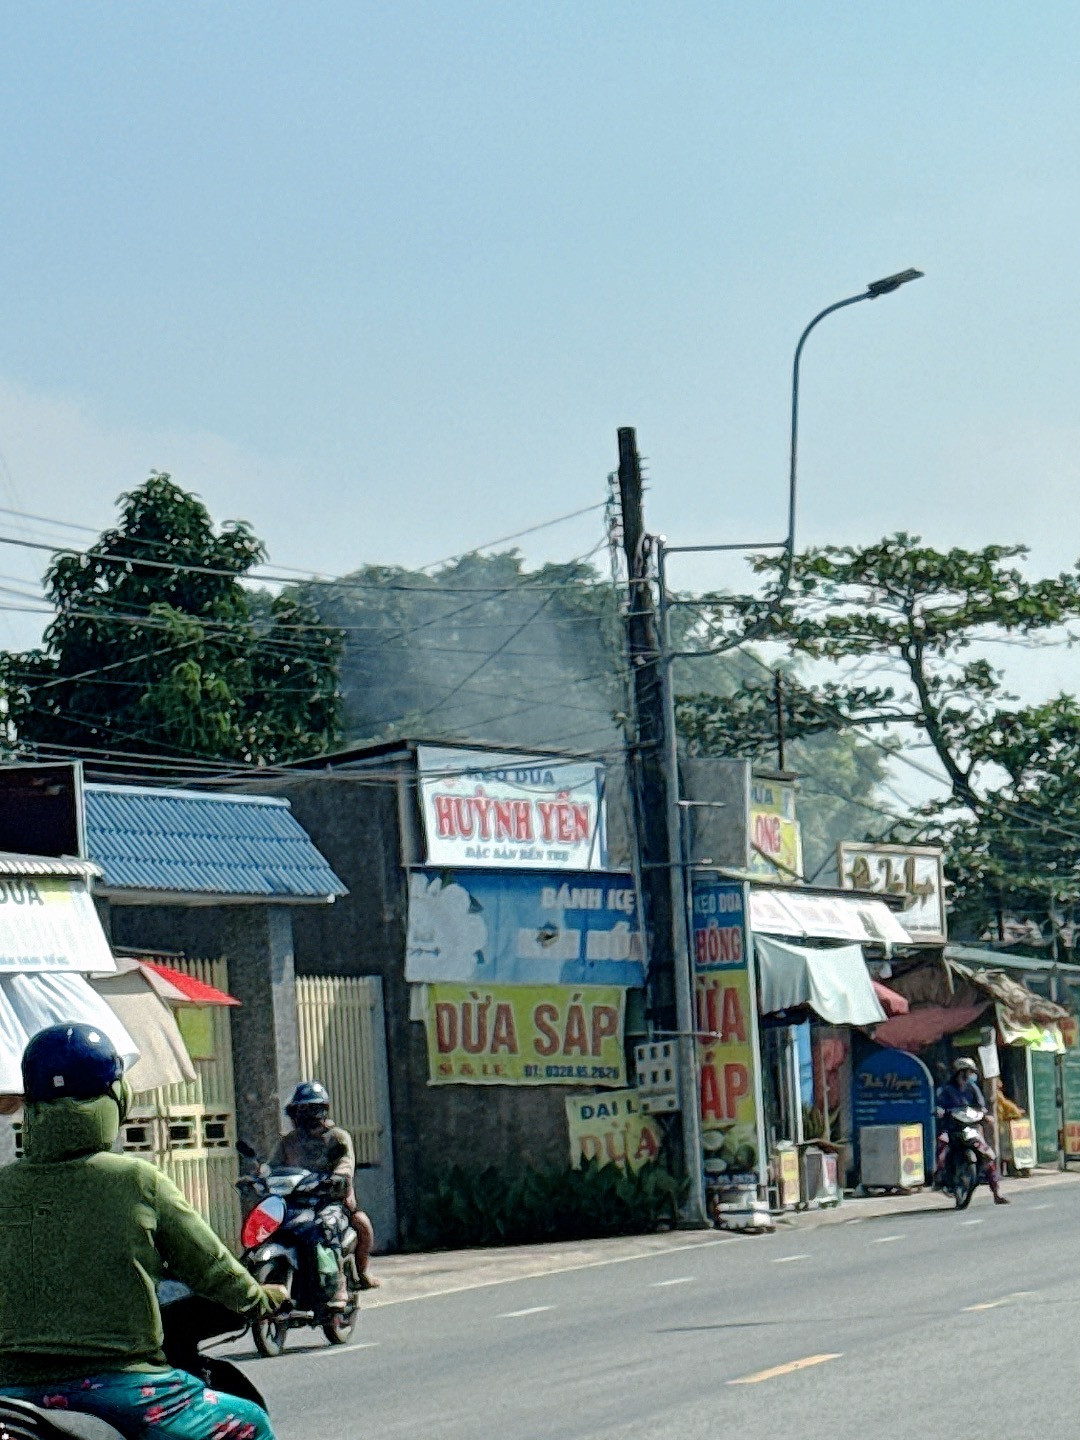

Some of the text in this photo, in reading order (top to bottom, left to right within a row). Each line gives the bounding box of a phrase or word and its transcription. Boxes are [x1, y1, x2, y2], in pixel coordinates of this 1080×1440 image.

[606, 888, 640, 915] KẸ
[435, 991, 618, 1056] DỪA SÁP
[696, 976, 747, 1046] ỪA
[700, 1051, 748, 1121] ÁP
